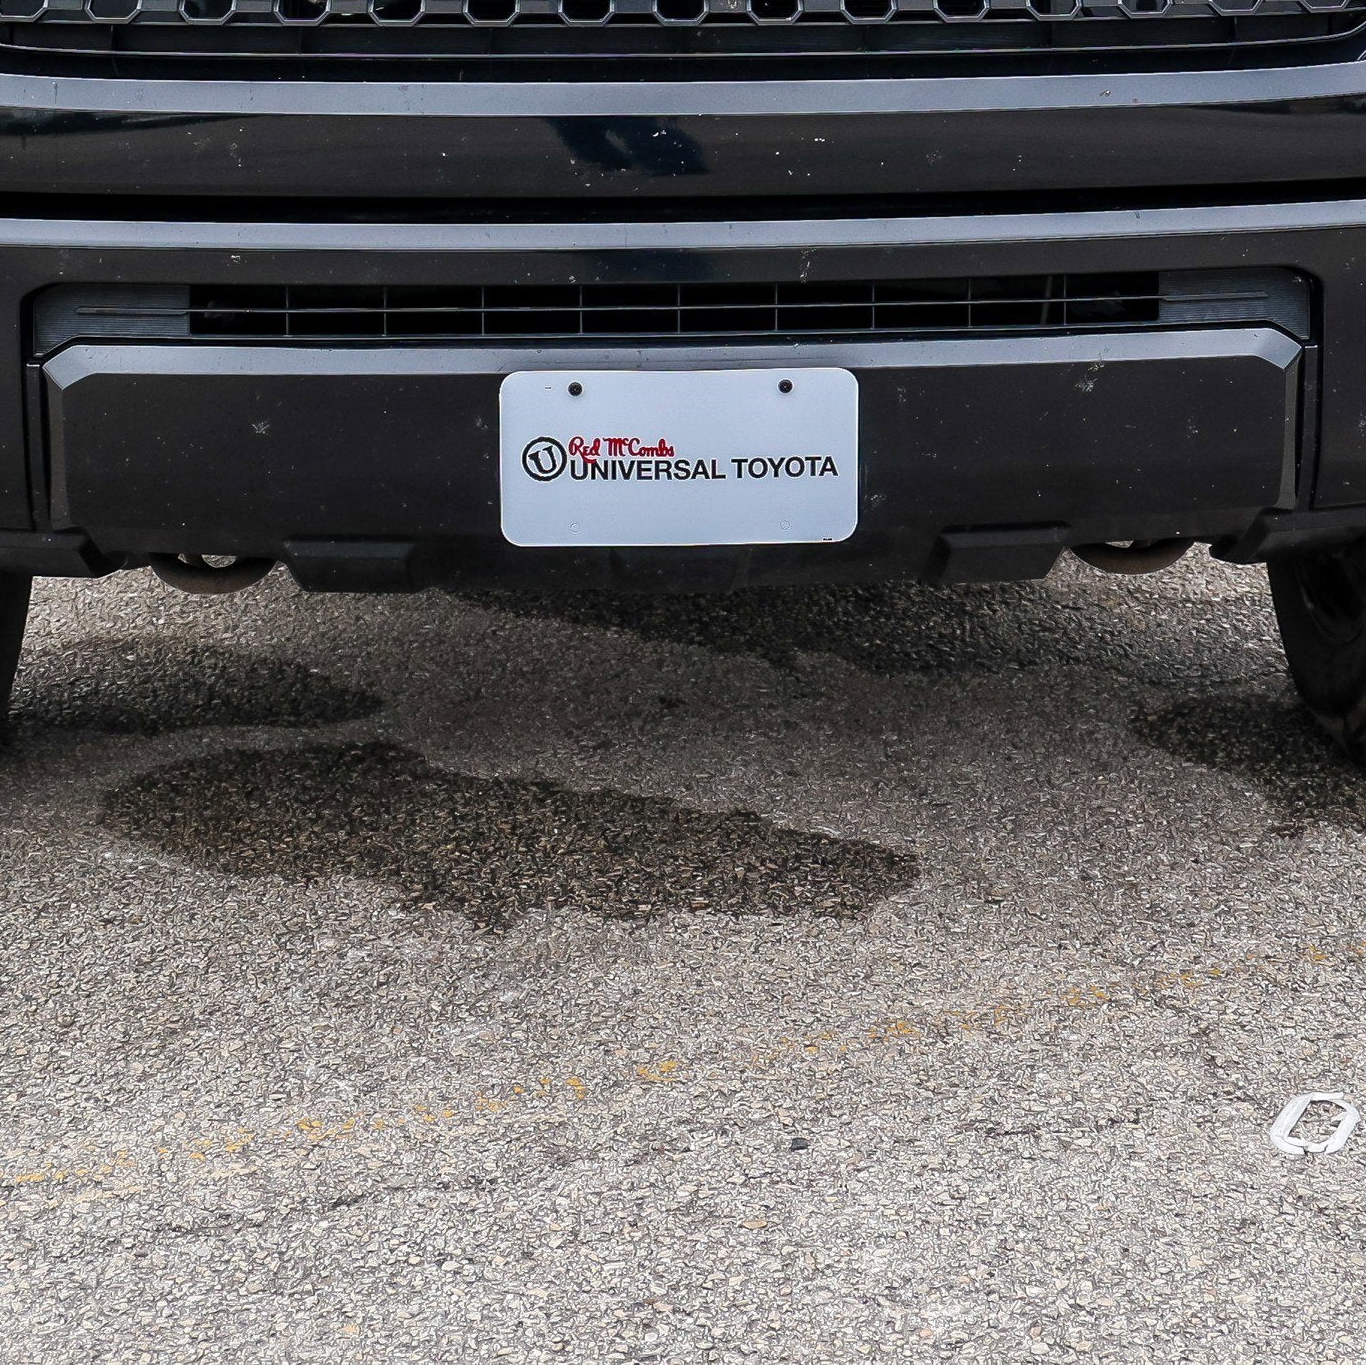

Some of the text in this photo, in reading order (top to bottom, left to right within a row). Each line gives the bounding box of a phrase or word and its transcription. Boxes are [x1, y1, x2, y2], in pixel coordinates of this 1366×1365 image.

[569, 436, 601, 464] Red
[570, 456, 839, 480] UNIVERSAL TOYOTA
